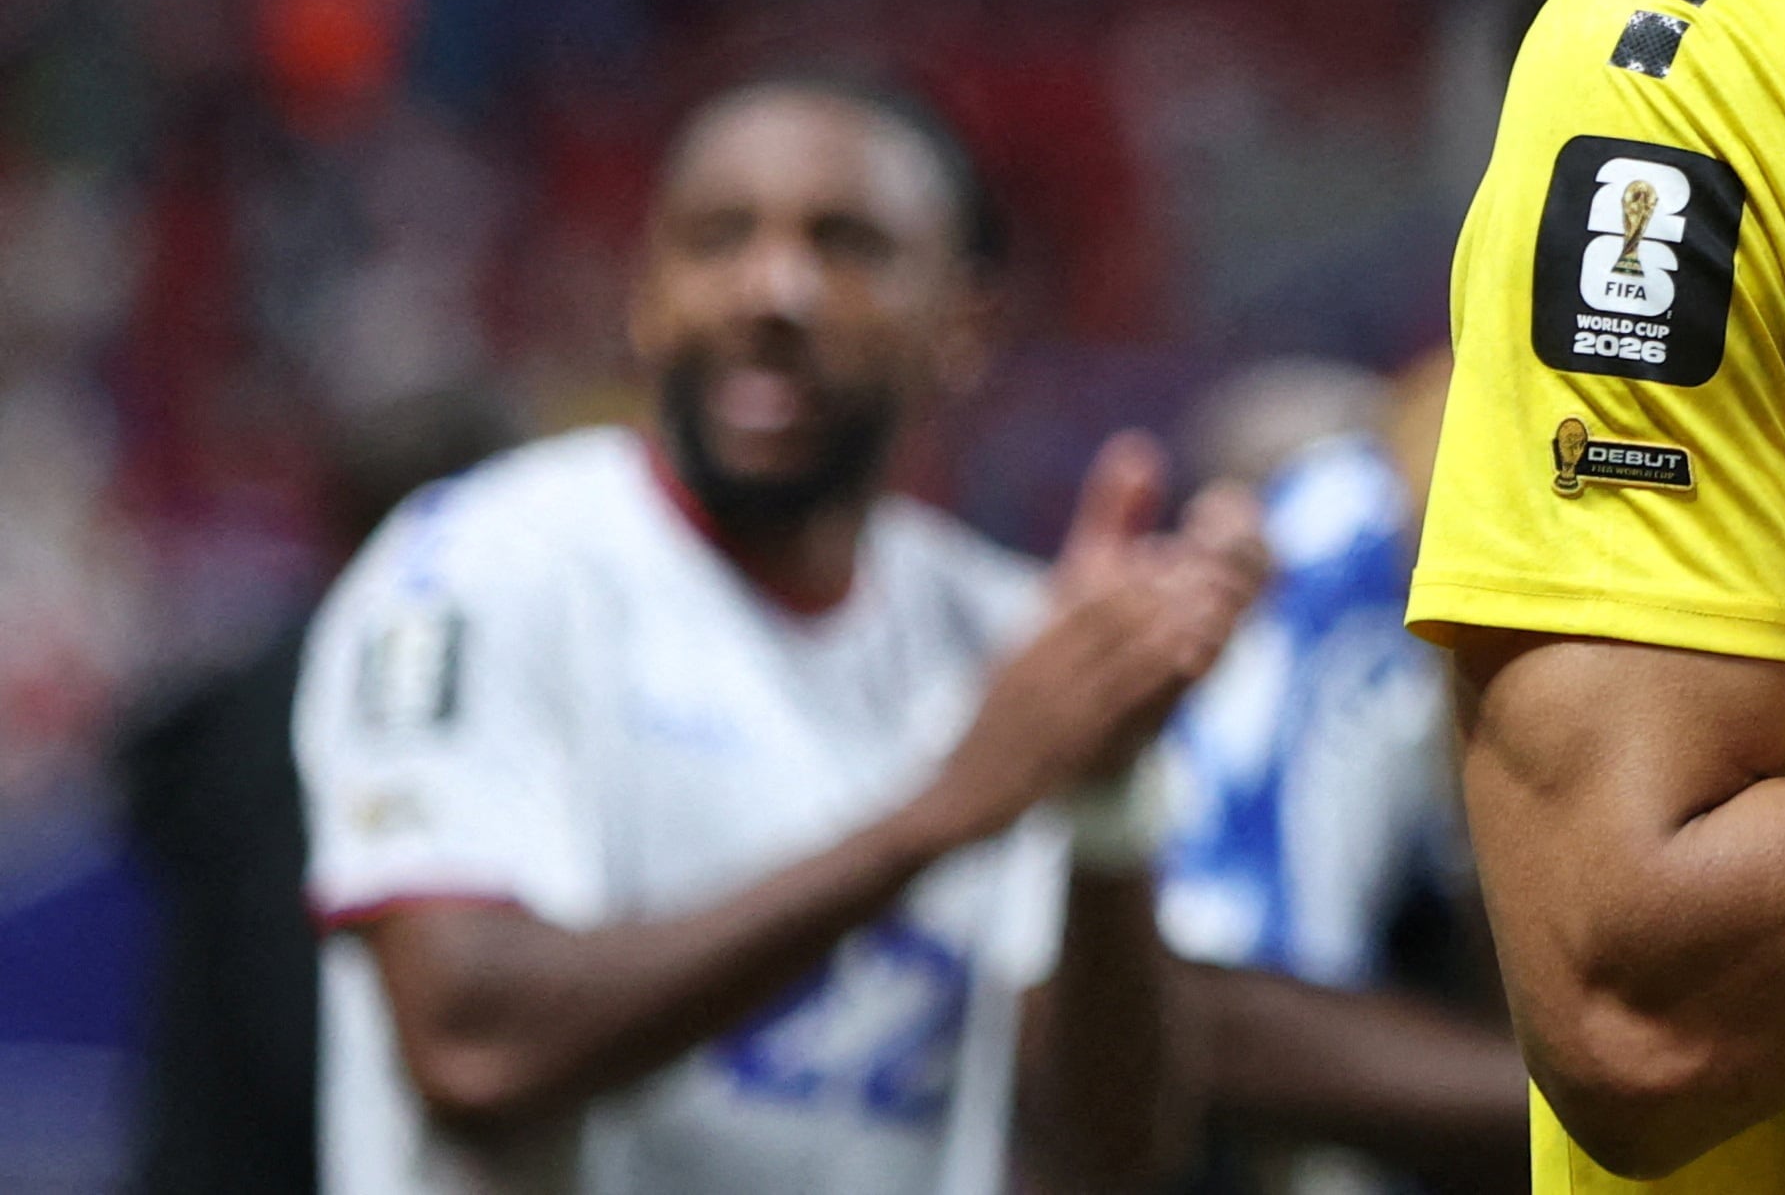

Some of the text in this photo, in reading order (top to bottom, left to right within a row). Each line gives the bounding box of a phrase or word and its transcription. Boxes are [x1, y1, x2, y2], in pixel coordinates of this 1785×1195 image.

[1604, 281, 1647, 301] FIFA
[1576, 314, 1670, 339] WORLD CUP
[1573, 331, 1667, 364] 2026
[1588, 447, 1682, 469] DEBUT
